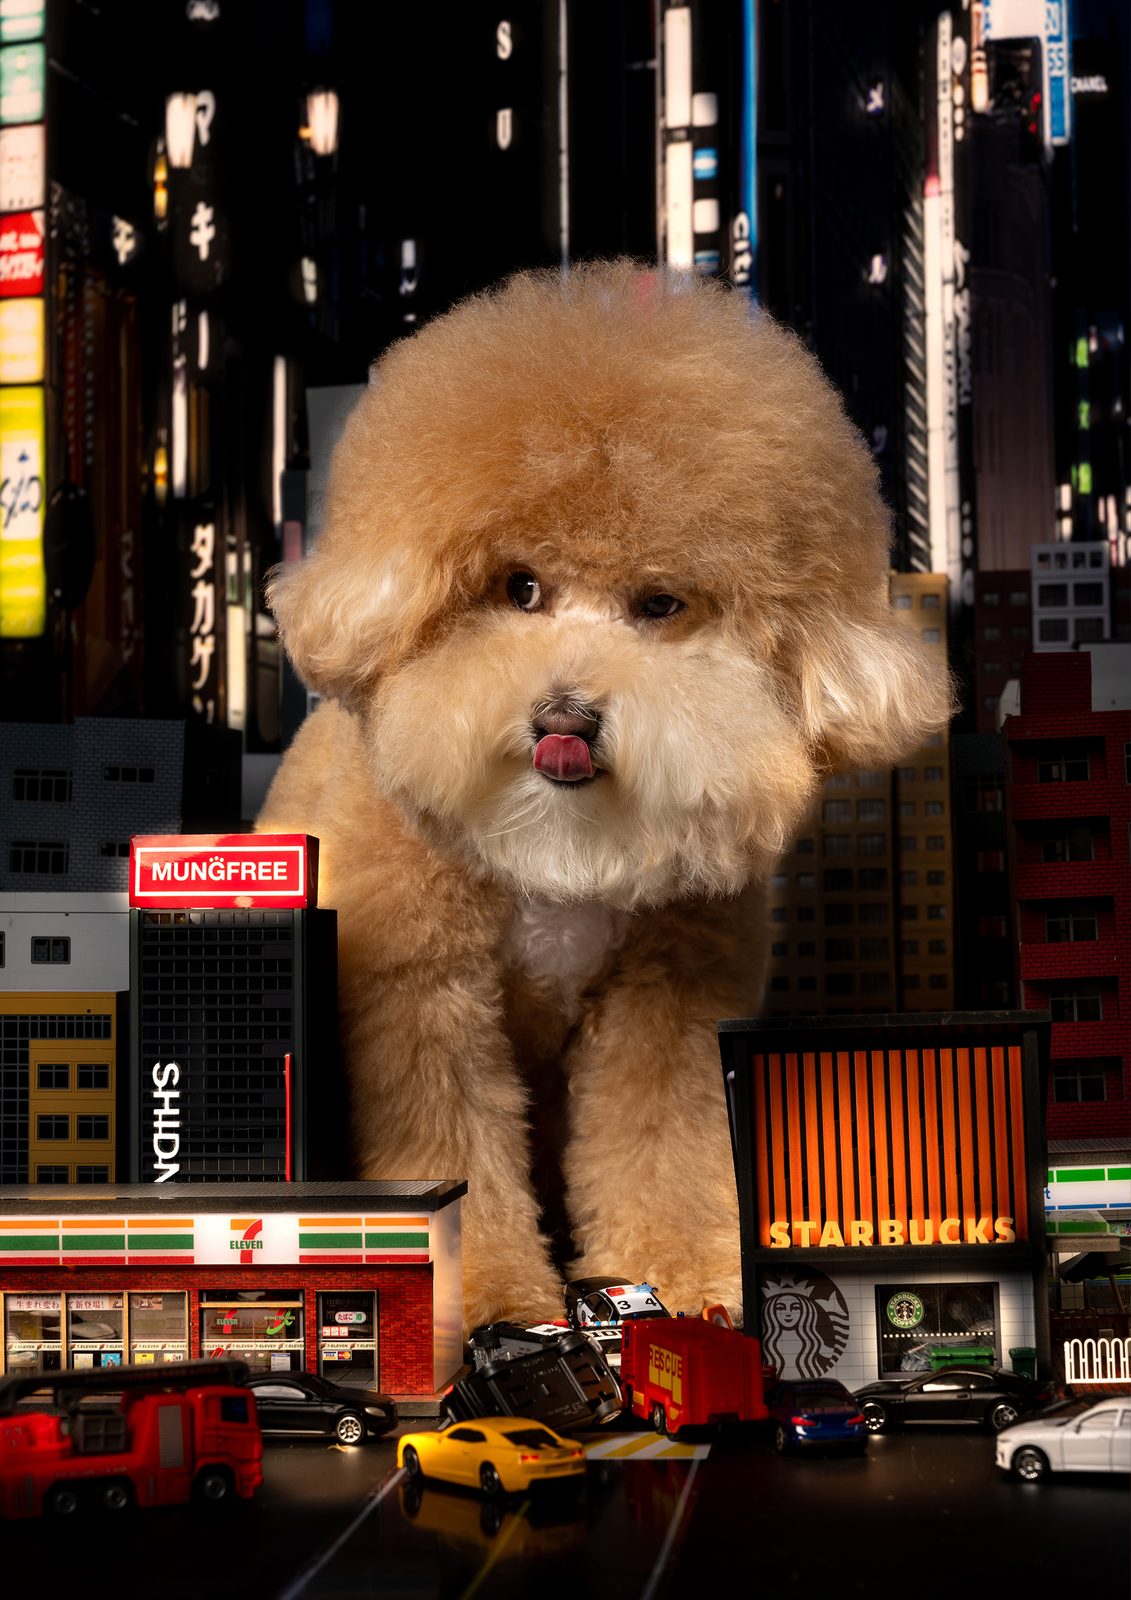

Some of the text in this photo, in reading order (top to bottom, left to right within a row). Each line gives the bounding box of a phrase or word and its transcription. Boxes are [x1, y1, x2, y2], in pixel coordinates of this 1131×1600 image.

[152, 856, 288, 881] MUNGFREE
[769, 1216, 1016, 1248] STARBUCKS
[889, 1294, 921, 1309] STARBUCKS
[892, 1316, 918, 1327] COFFEE
[649, 1347, 682, 1379] RESCUE
